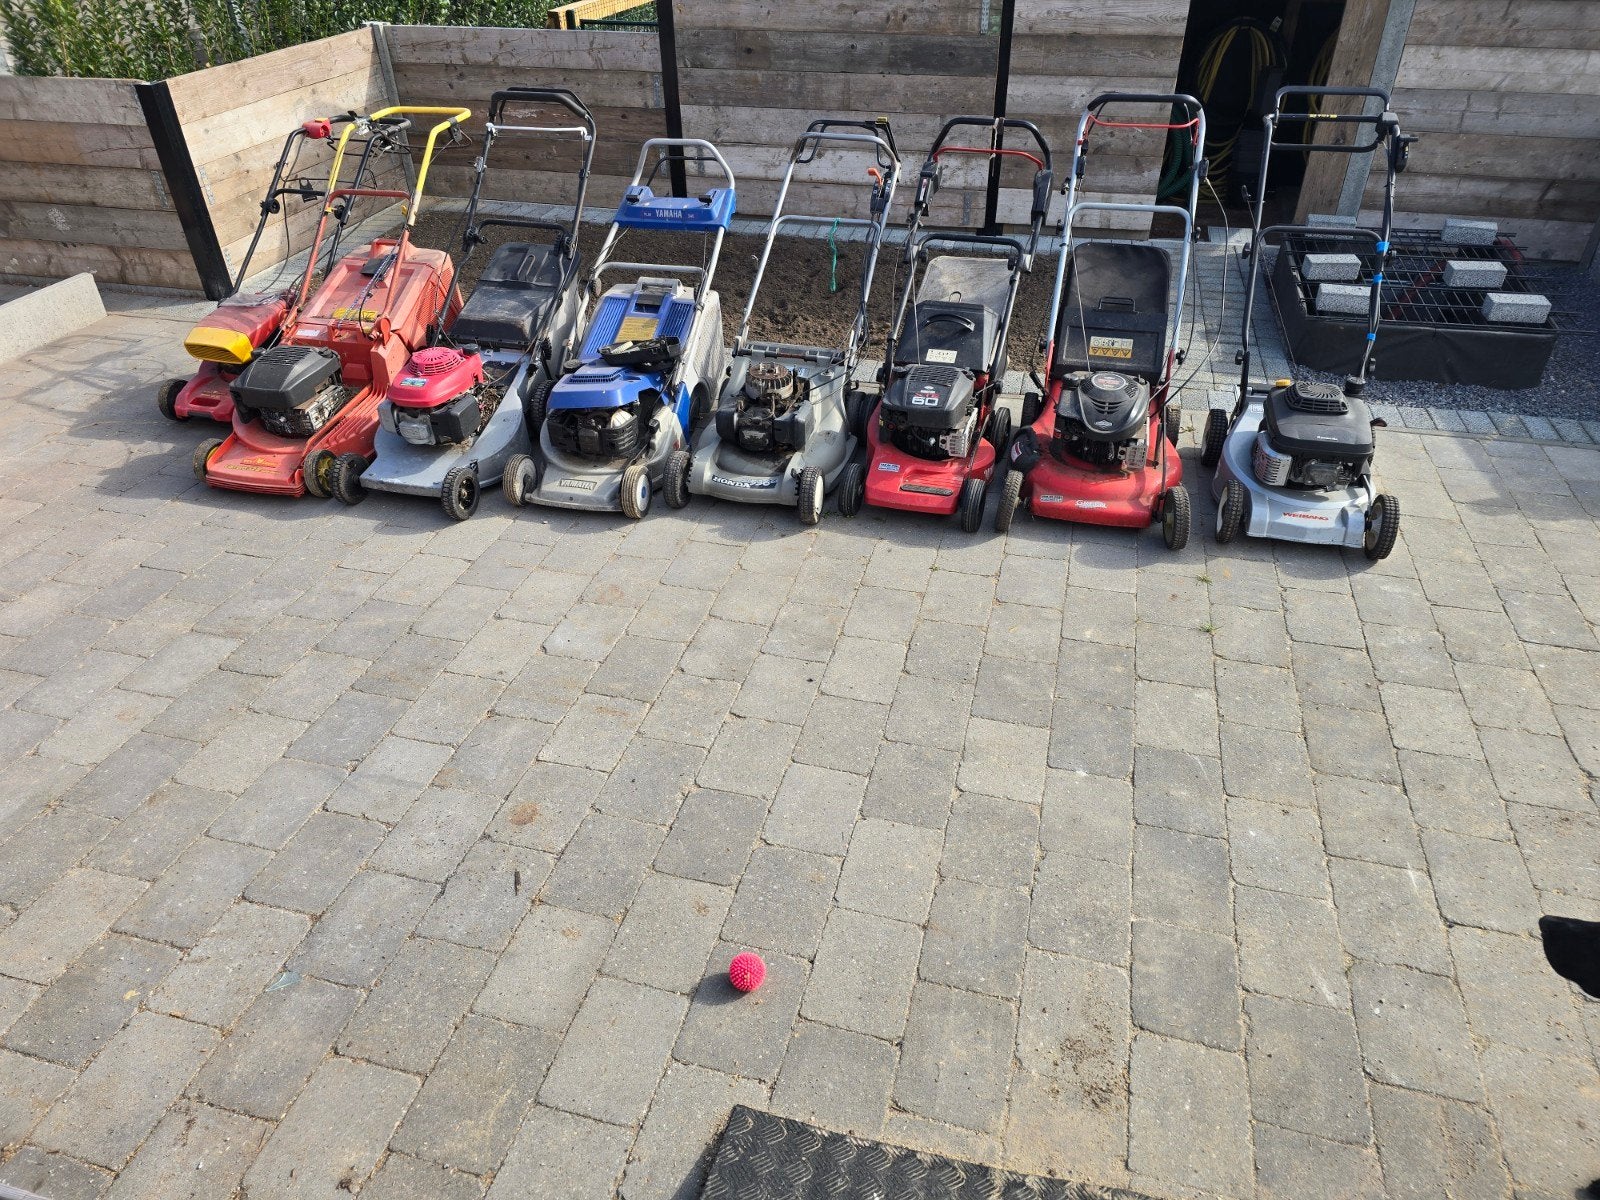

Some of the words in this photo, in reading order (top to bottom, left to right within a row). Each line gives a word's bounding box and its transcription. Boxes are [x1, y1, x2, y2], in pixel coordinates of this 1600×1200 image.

[655, 209, 683, 218] YAMAHA
[911, 397, 939, 406] 60
[561, 480, 594, 490] YAMAHA
[712, 476, 751, 489] HONDA
